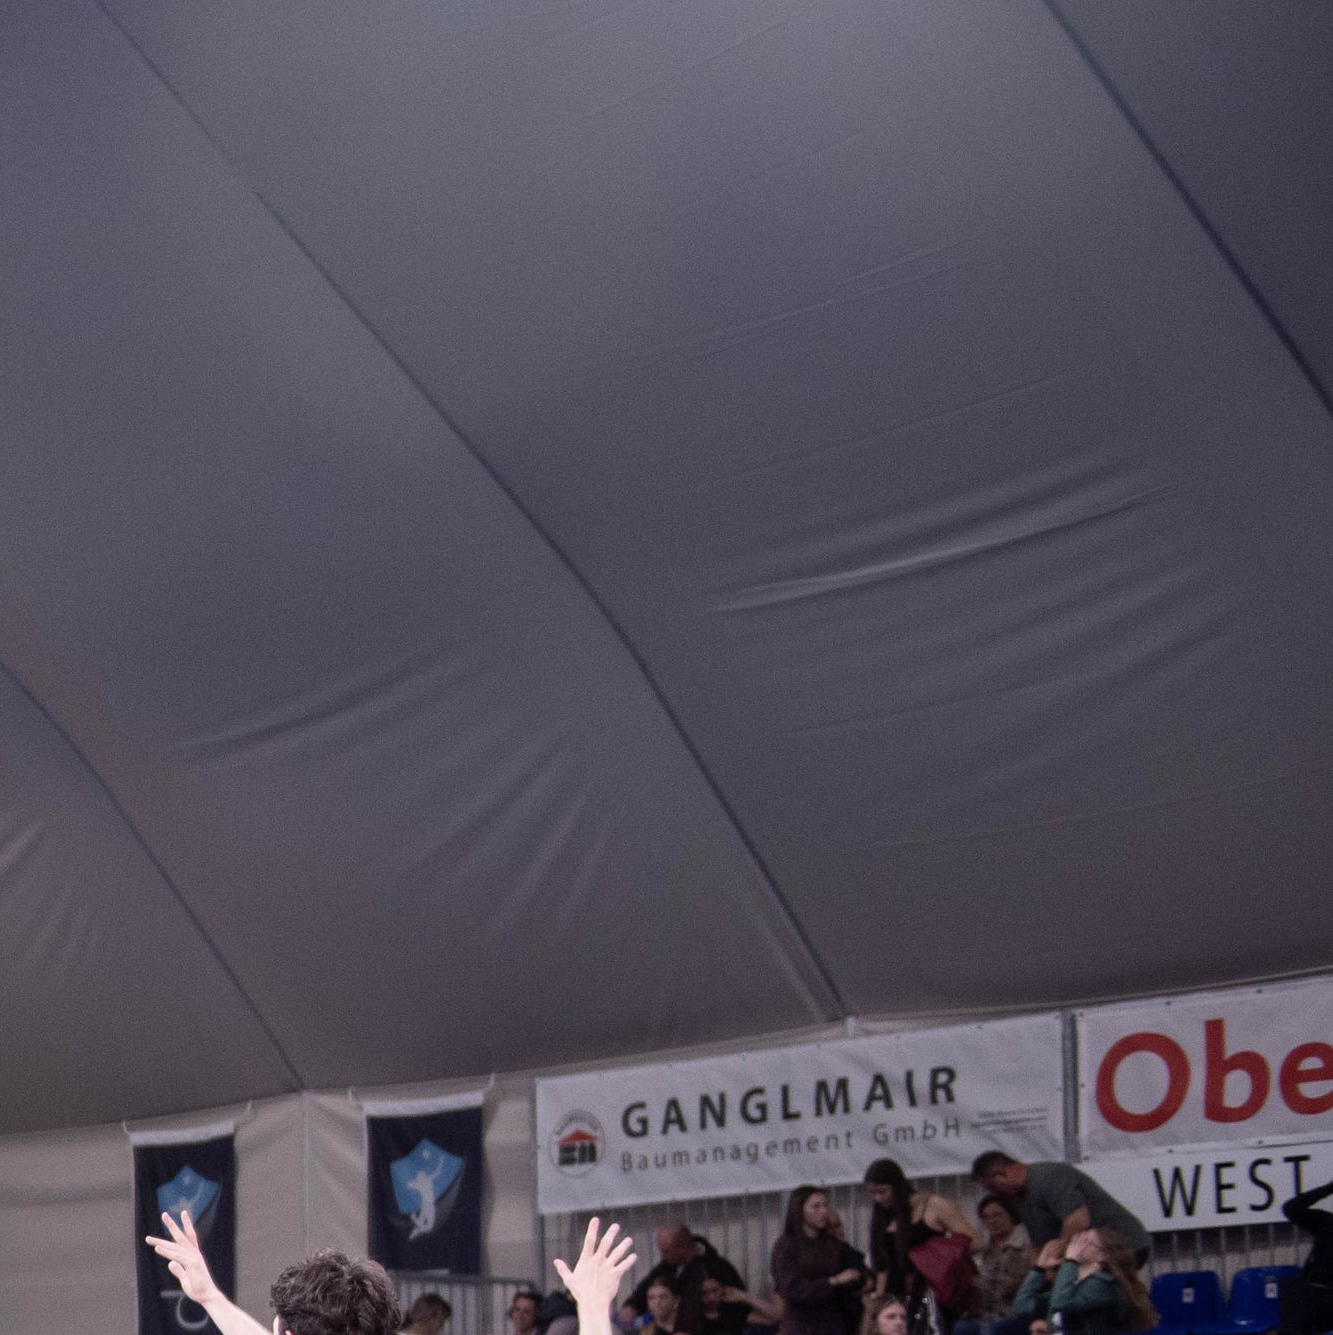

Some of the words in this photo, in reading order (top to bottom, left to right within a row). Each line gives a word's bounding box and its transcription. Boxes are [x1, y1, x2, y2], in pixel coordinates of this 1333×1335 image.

[619, 1064, 959, 1139] GANGLMAIR
[619, 1128, 855, 1173] Baumanagement
[872, 1116, 962, 1146] GmbH
[1151, 1153, 1312, 1219] WEST
